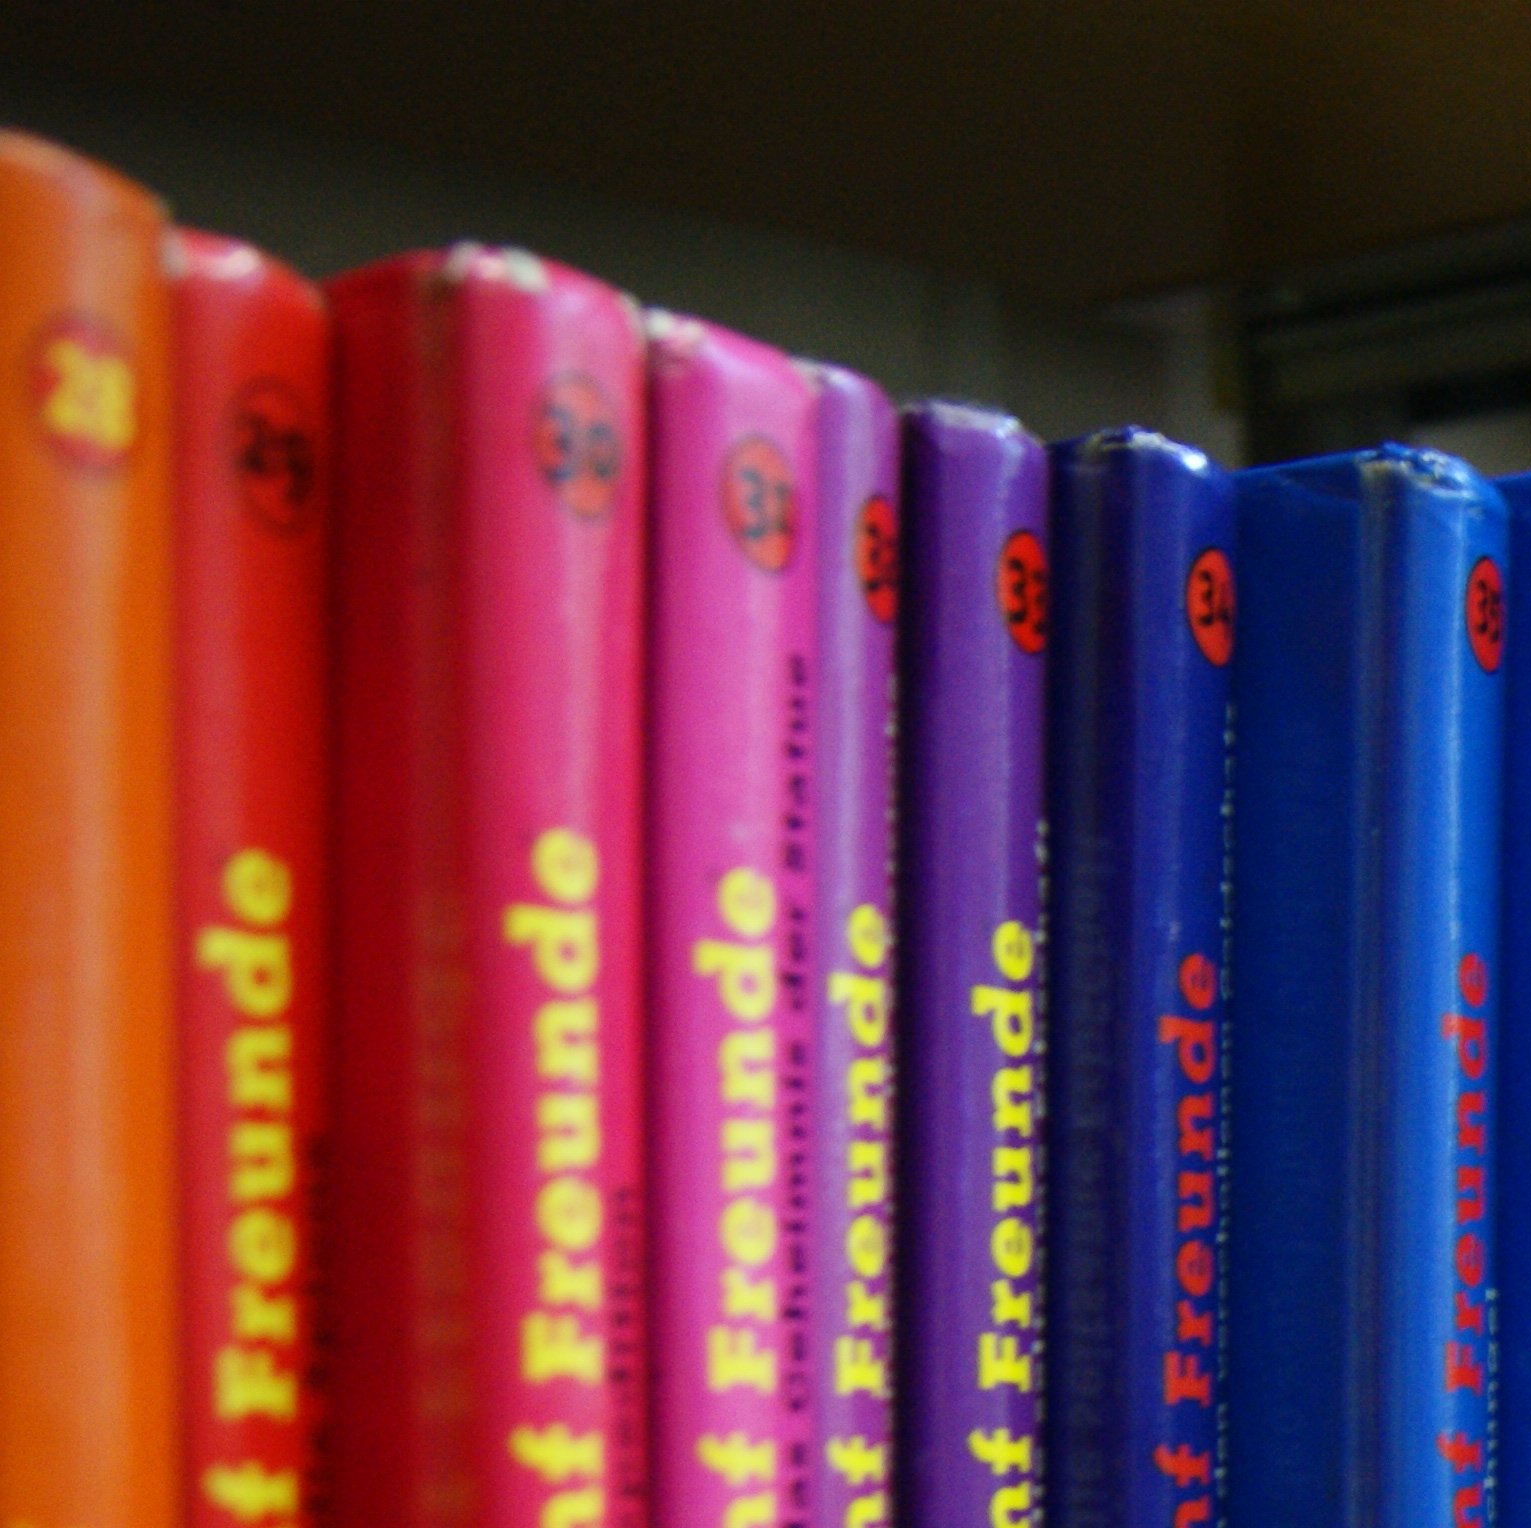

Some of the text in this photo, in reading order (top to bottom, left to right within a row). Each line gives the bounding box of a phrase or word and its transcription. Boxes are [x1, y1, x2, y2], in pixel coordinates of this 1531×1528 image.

[197, 848, 297, 1421] Freunde
[504, 828, 604, 1384] Freunde
[695, 868, 779, 1391] Freunde
[829, 903, 891, 1398] Freunde
[973, 921, 1034, 1391] Freunde
[1160, 952, 1217, 1406] Freunde
[1441, 952, 1489, 1395] Freunde
